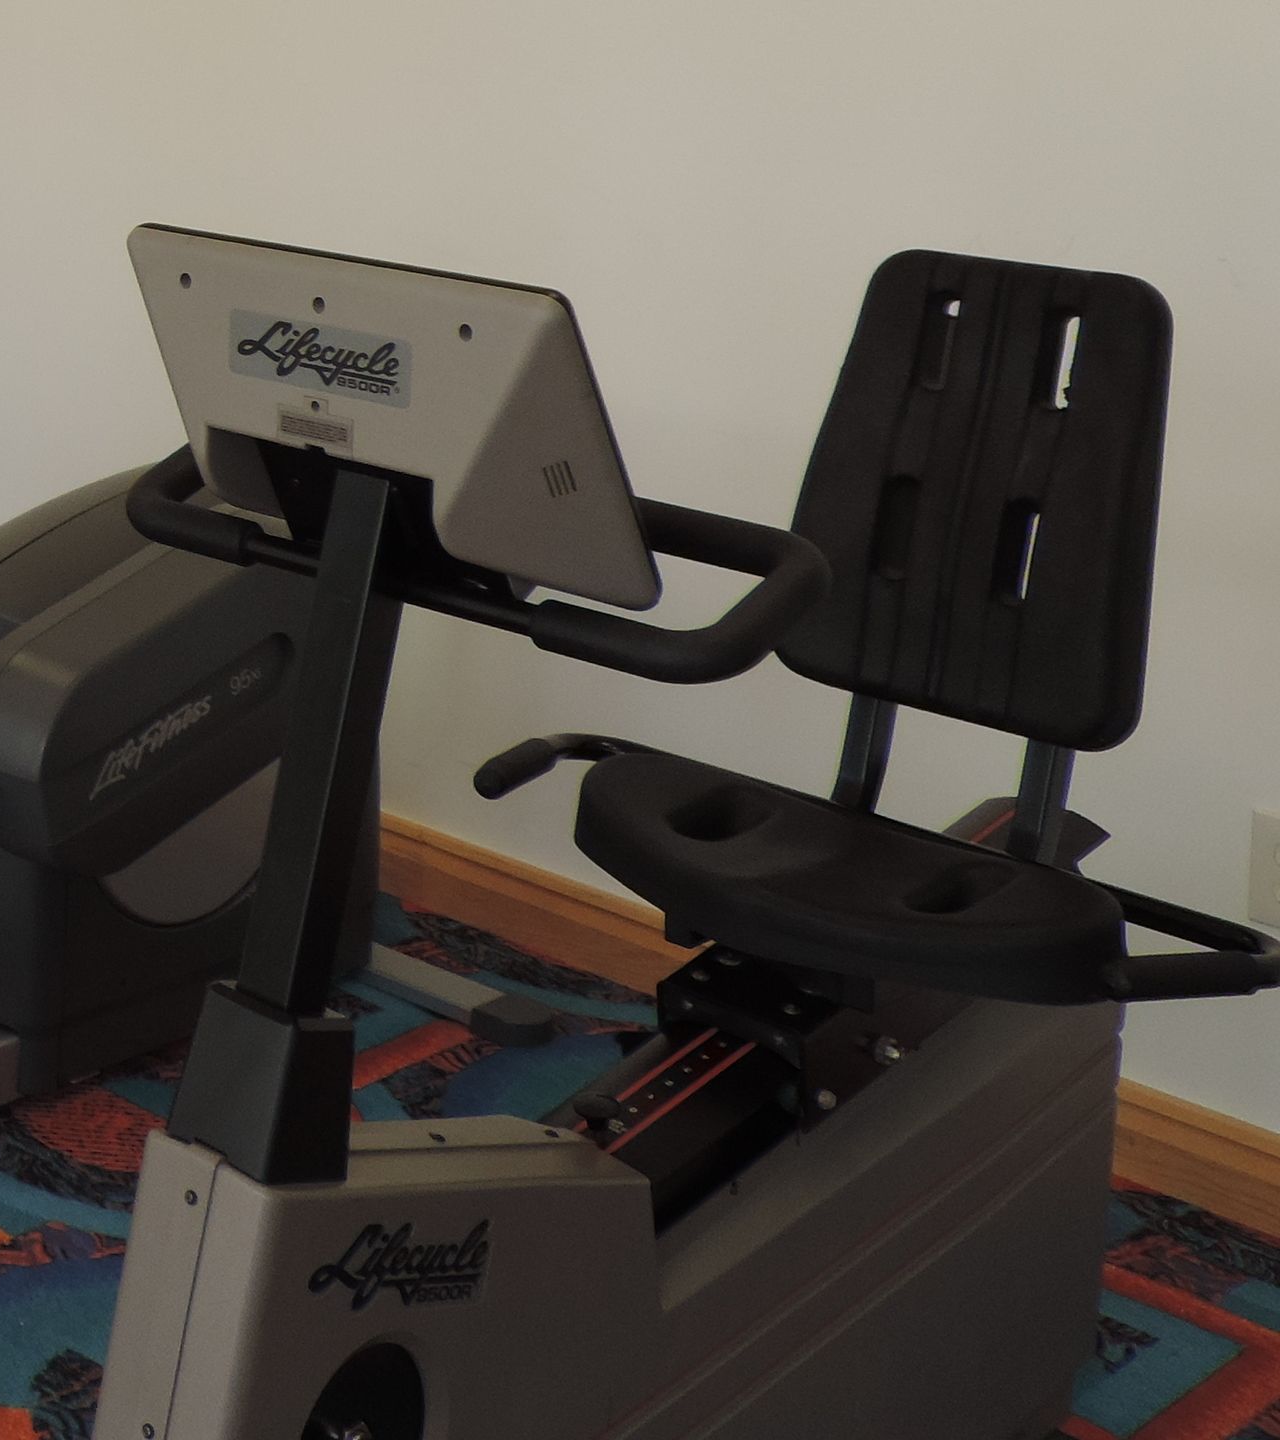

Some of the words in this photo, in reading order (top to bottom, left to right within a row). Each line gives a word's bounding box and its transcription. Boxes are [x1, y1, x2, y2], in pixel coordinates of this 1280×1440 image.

[237, 320, 400, 386] Lifecycle
[336, 376, 391, 397] 9500R
[308, 1218, 490, 1311] Lifecycle
